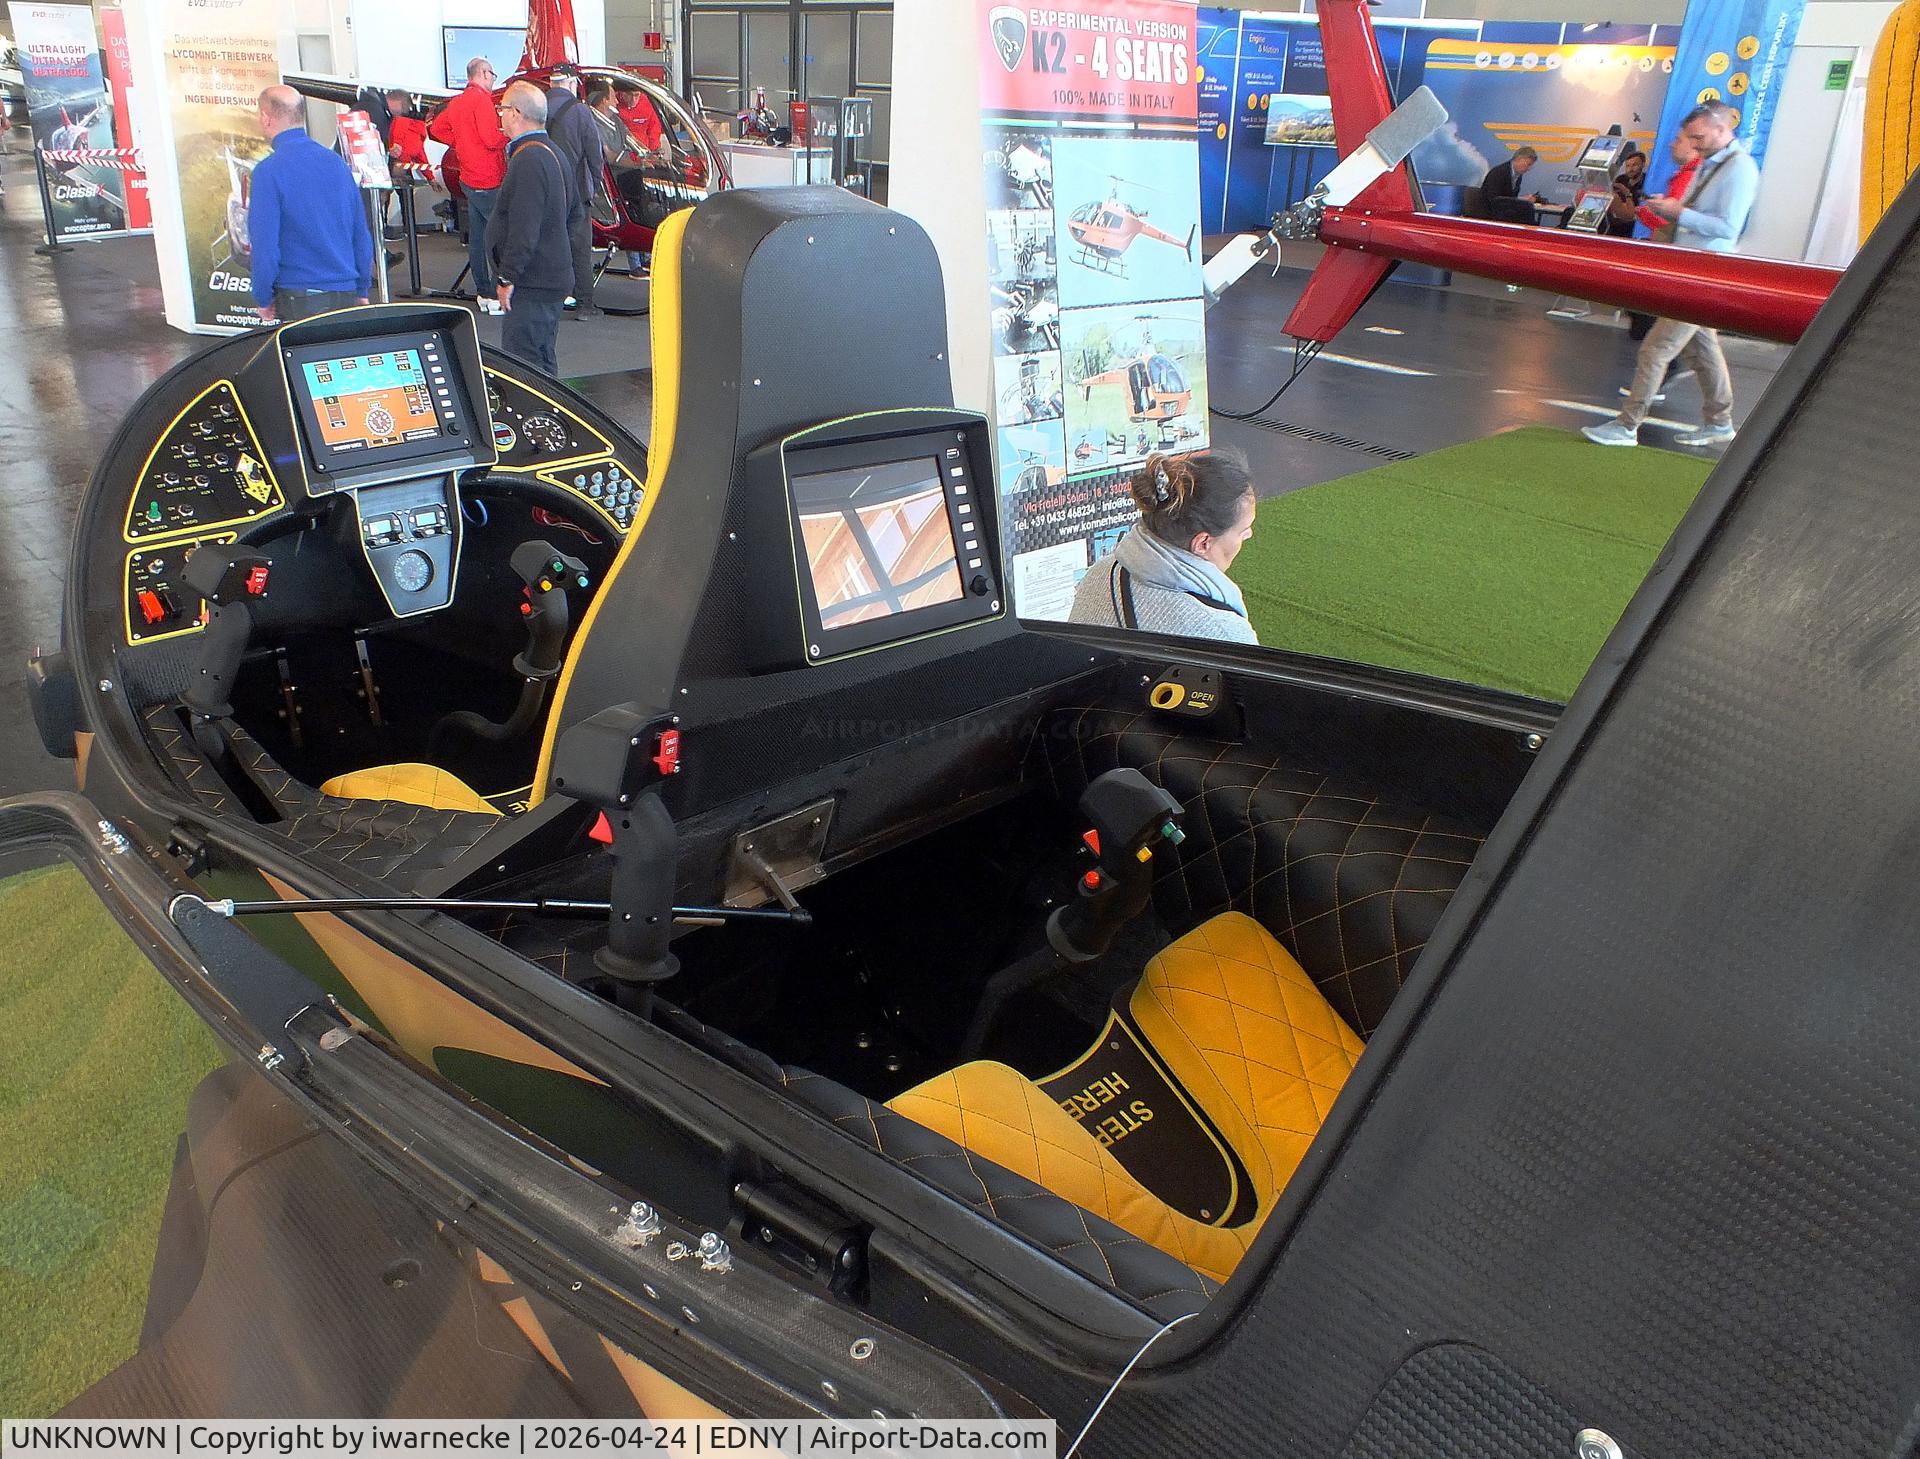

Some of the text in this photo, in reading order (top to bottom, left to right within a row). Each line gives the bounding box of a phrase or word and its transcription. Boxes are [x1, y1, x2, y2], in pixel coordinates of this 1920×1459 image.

[1030, 9, 1187, 41] EXPERIMENTAL VERSION
[28, 44, 86, 54] ULTRA LIGHT
[172, 49, 274, 62] LYCOMING-TRIEBWERK
[1031, 30, 1067, 74] K2
[1091, 35, 1109, 79] 4
[1115, 36, 1189, 86] SEATS
[31, 56, 88, 66] ULTRA SAFE
[184, 94, 260, 106] INGENIEURSKUN
[1053, 89, 1175, 110] 100% MADE IN ITALY
[64, 223, 112, 233] evocopter.aero
[208, 271, 253, 292] Clas
[1023, 503, 1037, 514] Via
[1039, 497, 1066, 511] Fratelli
[1109, 481, 1132, 495] 33020
[1014, 520, 1029, 532] Tel.
[1030, 514, 1046, 527] +39
[1046, 510, 1066, 523] 0433
[1067, 504, 1096, 519] 468234
[1191, 691, 1215, 702] OPEN
[1060, 1071, 1131, 1120] HERE
[1096, 1100, 1154, 1148] STEP
